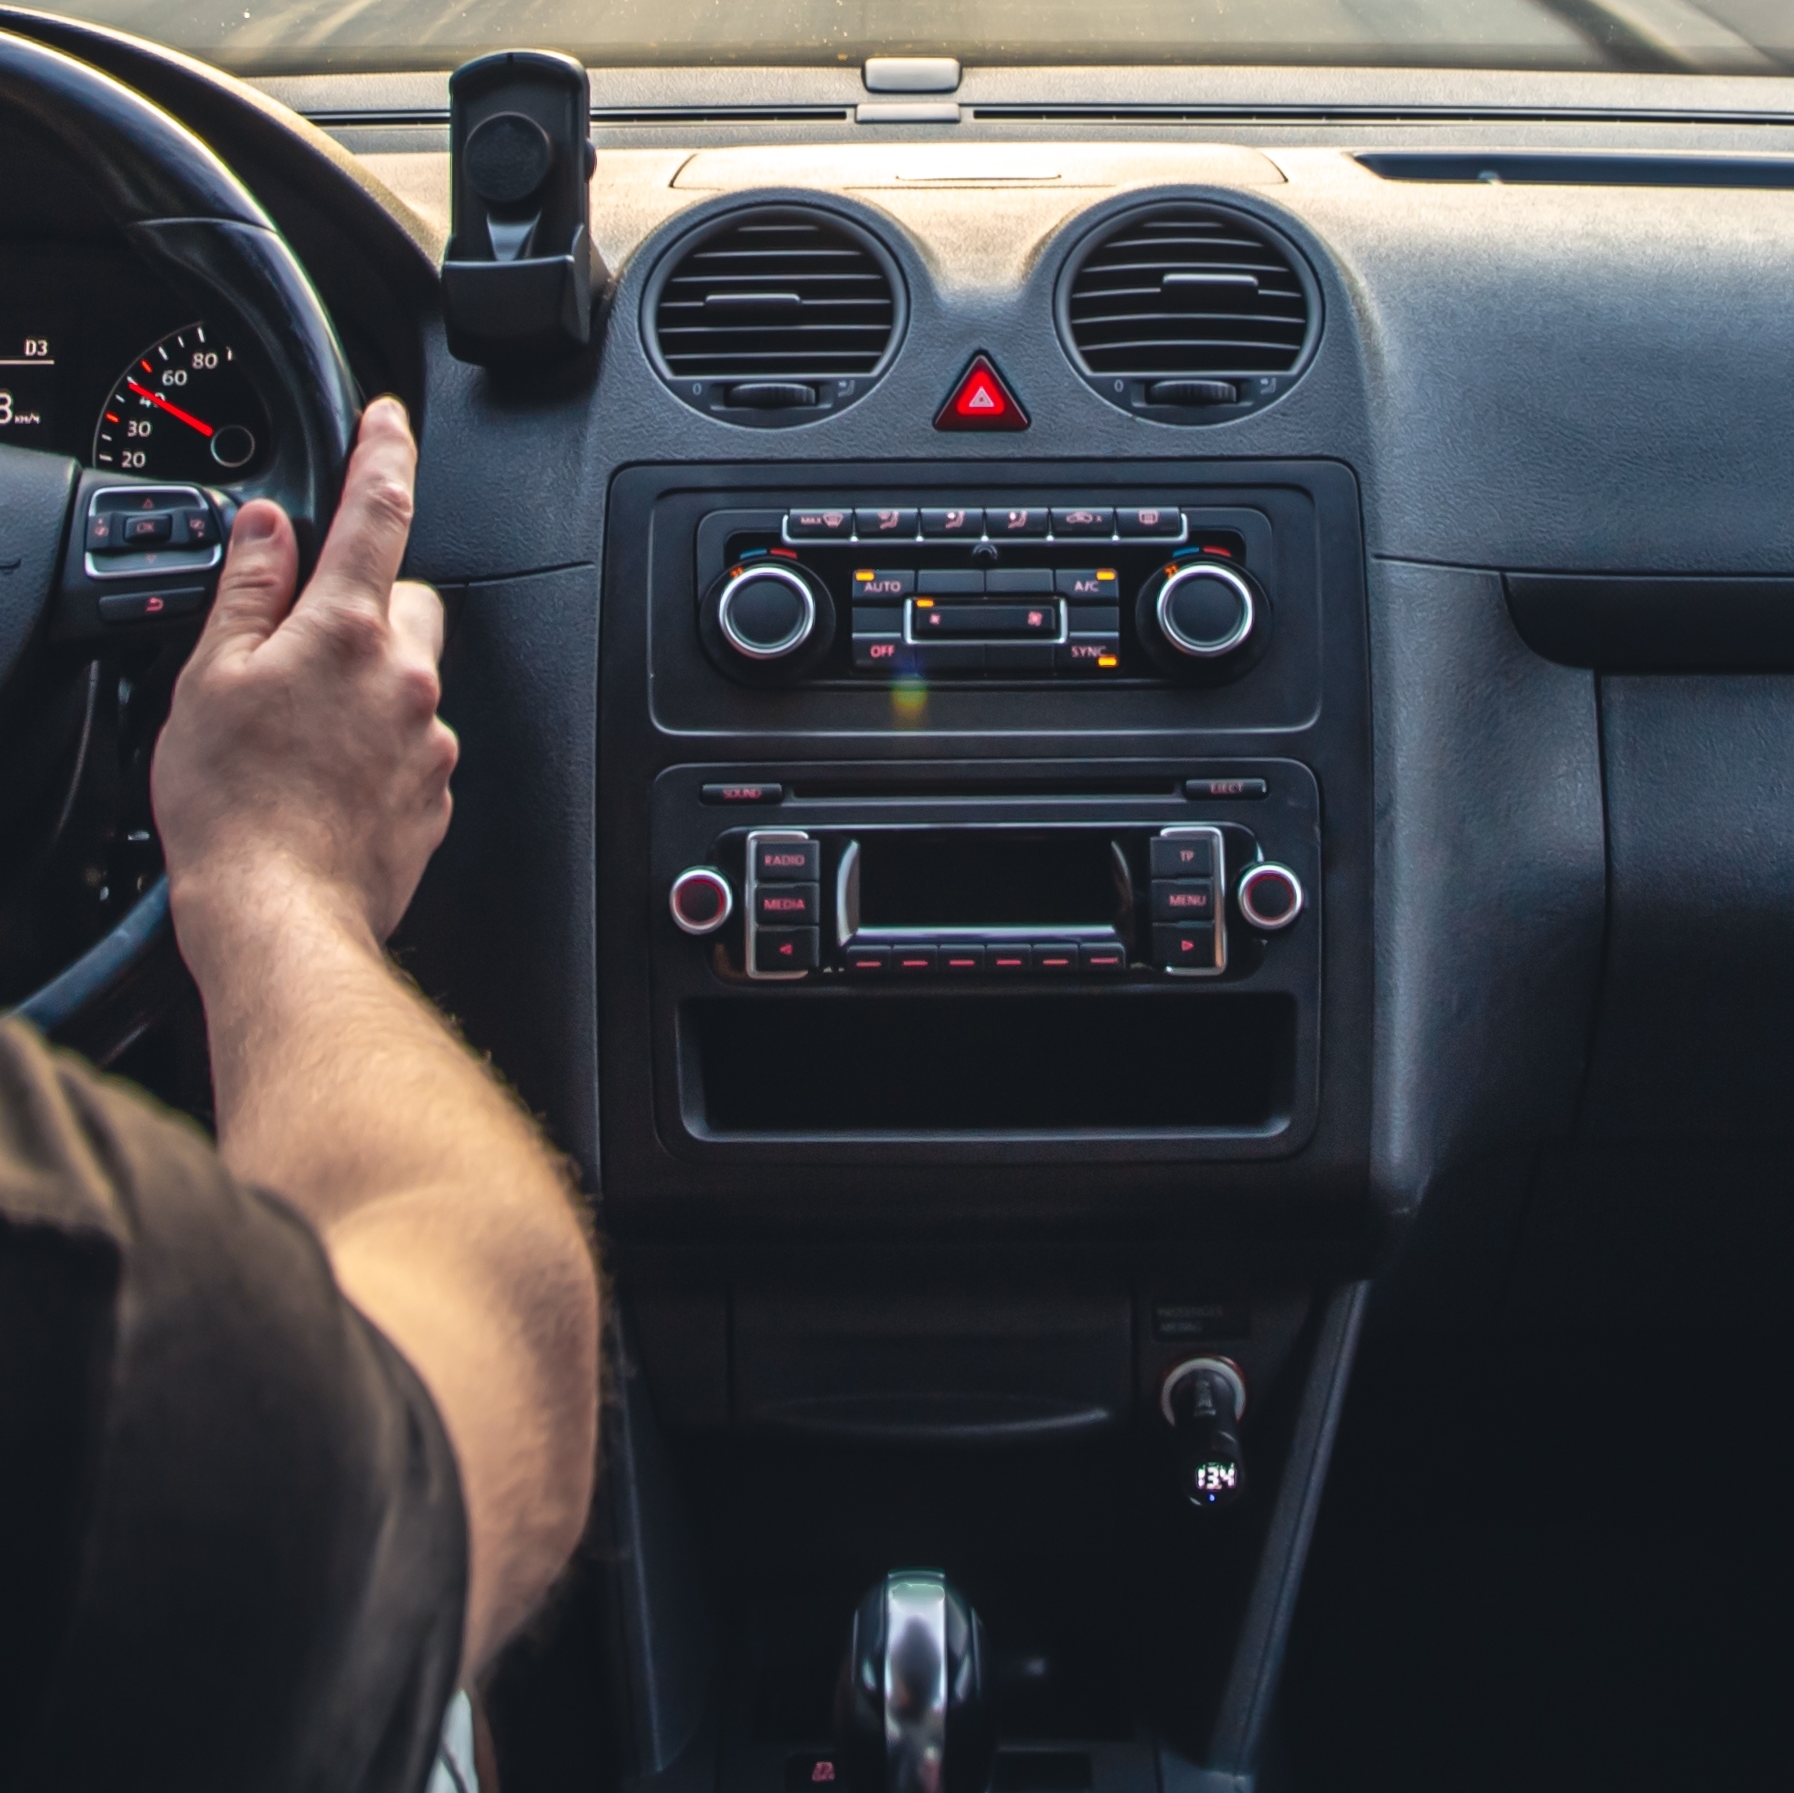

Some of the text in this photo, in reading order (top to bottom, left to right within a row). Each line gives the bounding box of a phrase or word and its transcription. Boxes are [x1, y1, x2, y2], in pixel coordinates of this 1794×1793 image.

[24, 338, 48, 356] D3
[192, 352, 218, 369] 80
[162, 369, 188, 386] 60
[127, 420, 151, 437] 30
[121, 451, 146, 468] 20
[864, 580, 902, 593] AUTO
[1074, 580, 1100, 593] A/C
[870, 644, 895, 657] OFF
[1071, 646, 1106, 658] SYNC
[723, 787, 763, 800] SOUND
[1210, 782, 1244, 795] EJECT
[764, 855, 806, 866] RADIO
[1180, 850, 1195, 862] TP
[763, 898, 806, 910] MEDIA
[1169, 894, 1207, 906] MENU
